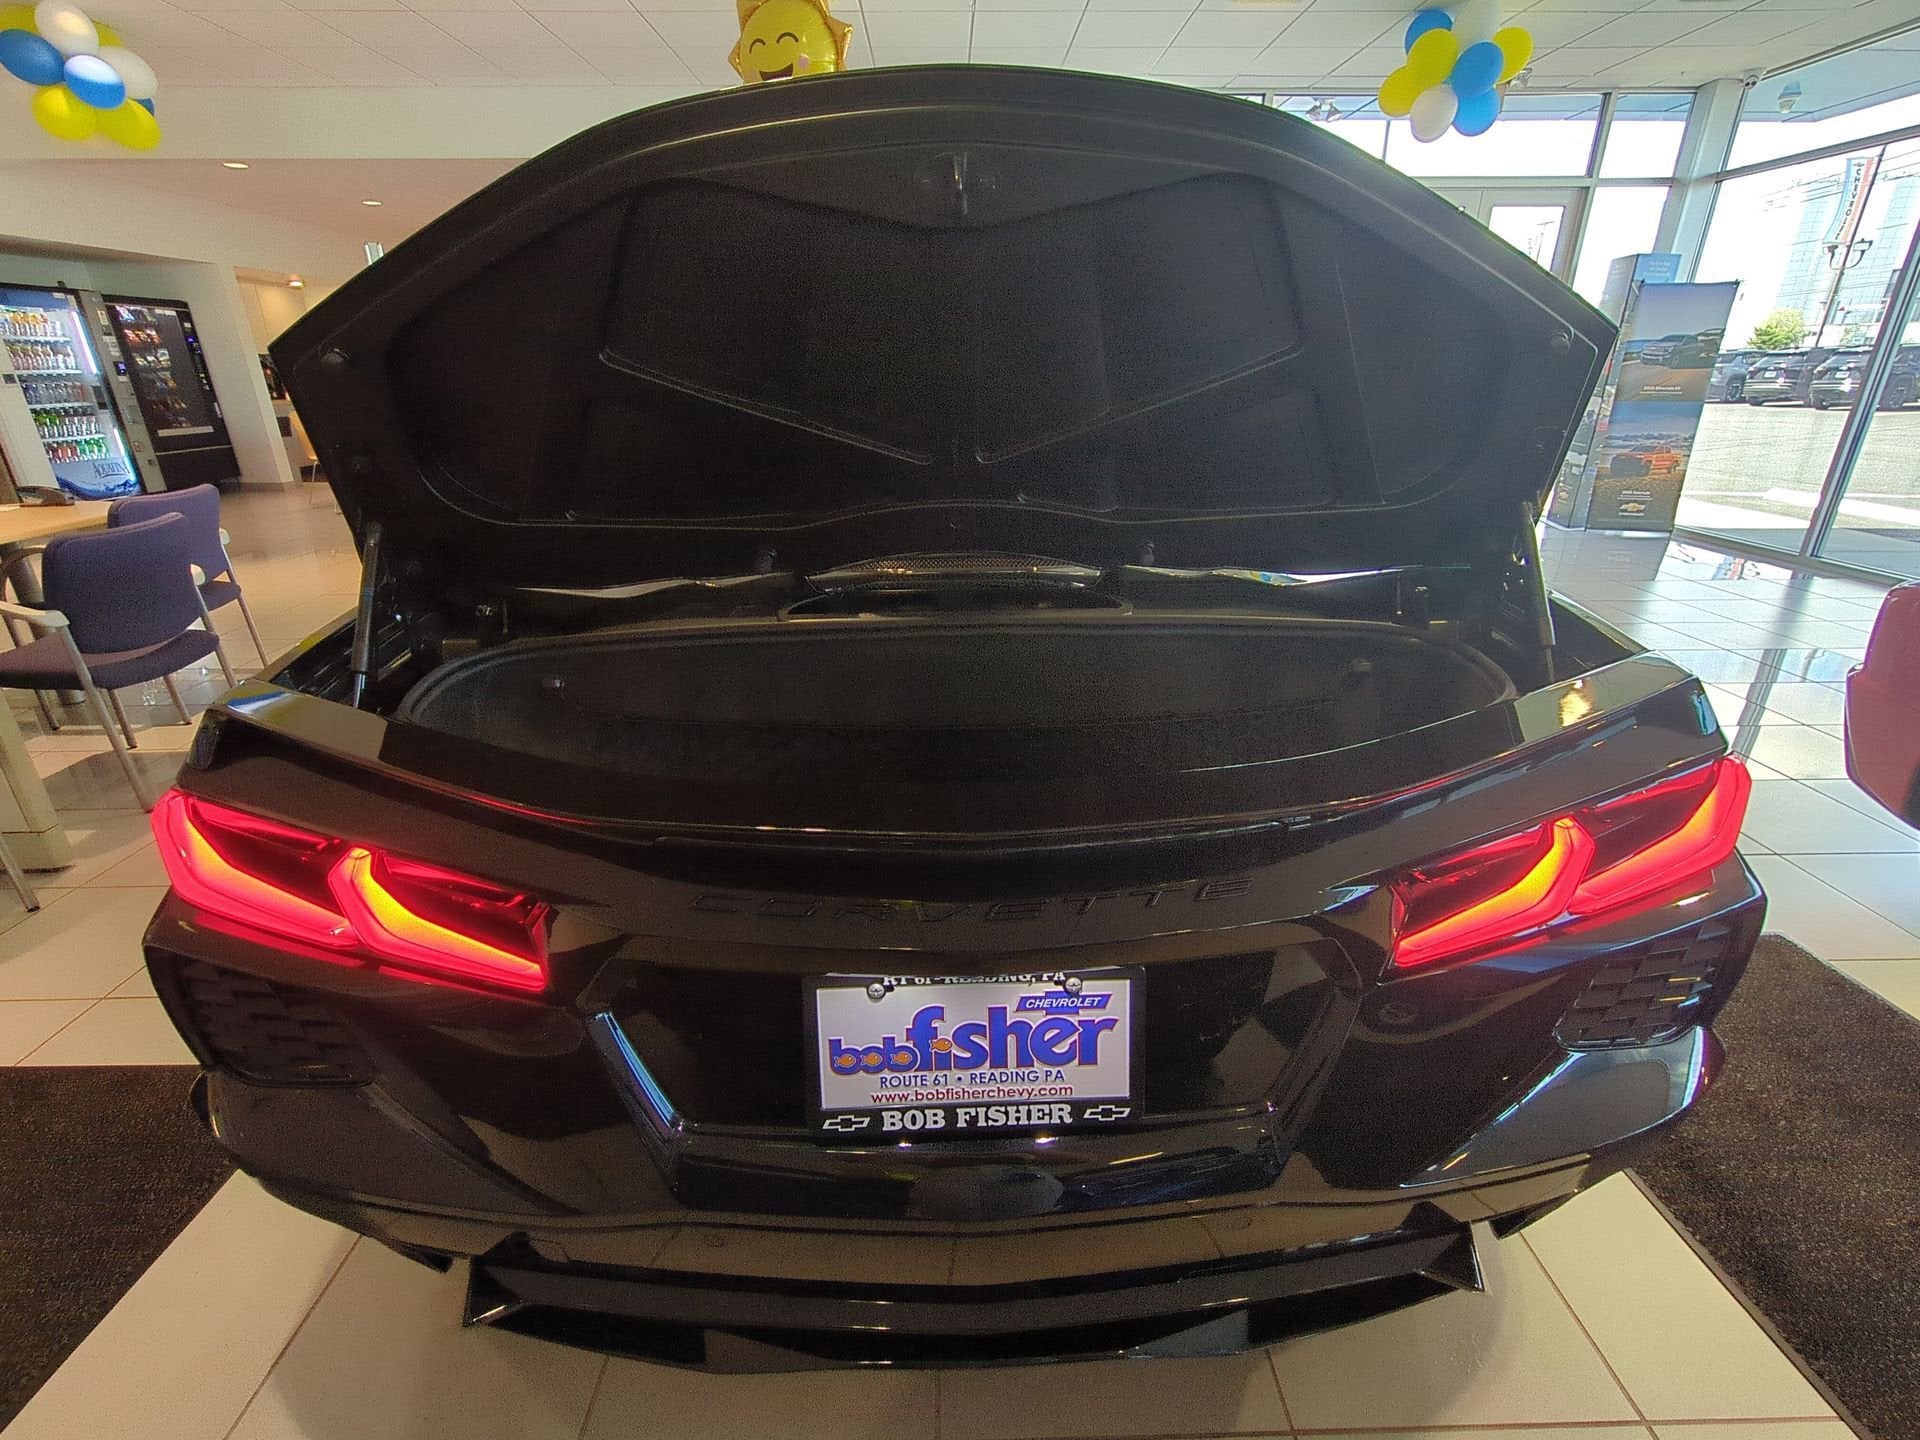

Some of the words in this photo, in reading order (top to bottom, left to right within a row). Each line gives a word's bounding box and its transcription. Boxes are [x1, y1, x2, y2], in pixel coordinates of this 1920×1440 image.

[690, 876, 1255, 923] CORVETTE
[1025, 996, 1102, 1009] CHEVROLET
[879, 1074, 928, 1089] ROUTE
[932, 1073, 949, 1087] 61
[969, 1070, 1040, 1084] READING
[1045, 1069, 1065, 1082] PA
[871, 1085, 1073, 1104] www.bobfisherchevy.com
[881, 1108, 946, 1131] BOB
[956, 1103, 1073, 1128] FISHER
